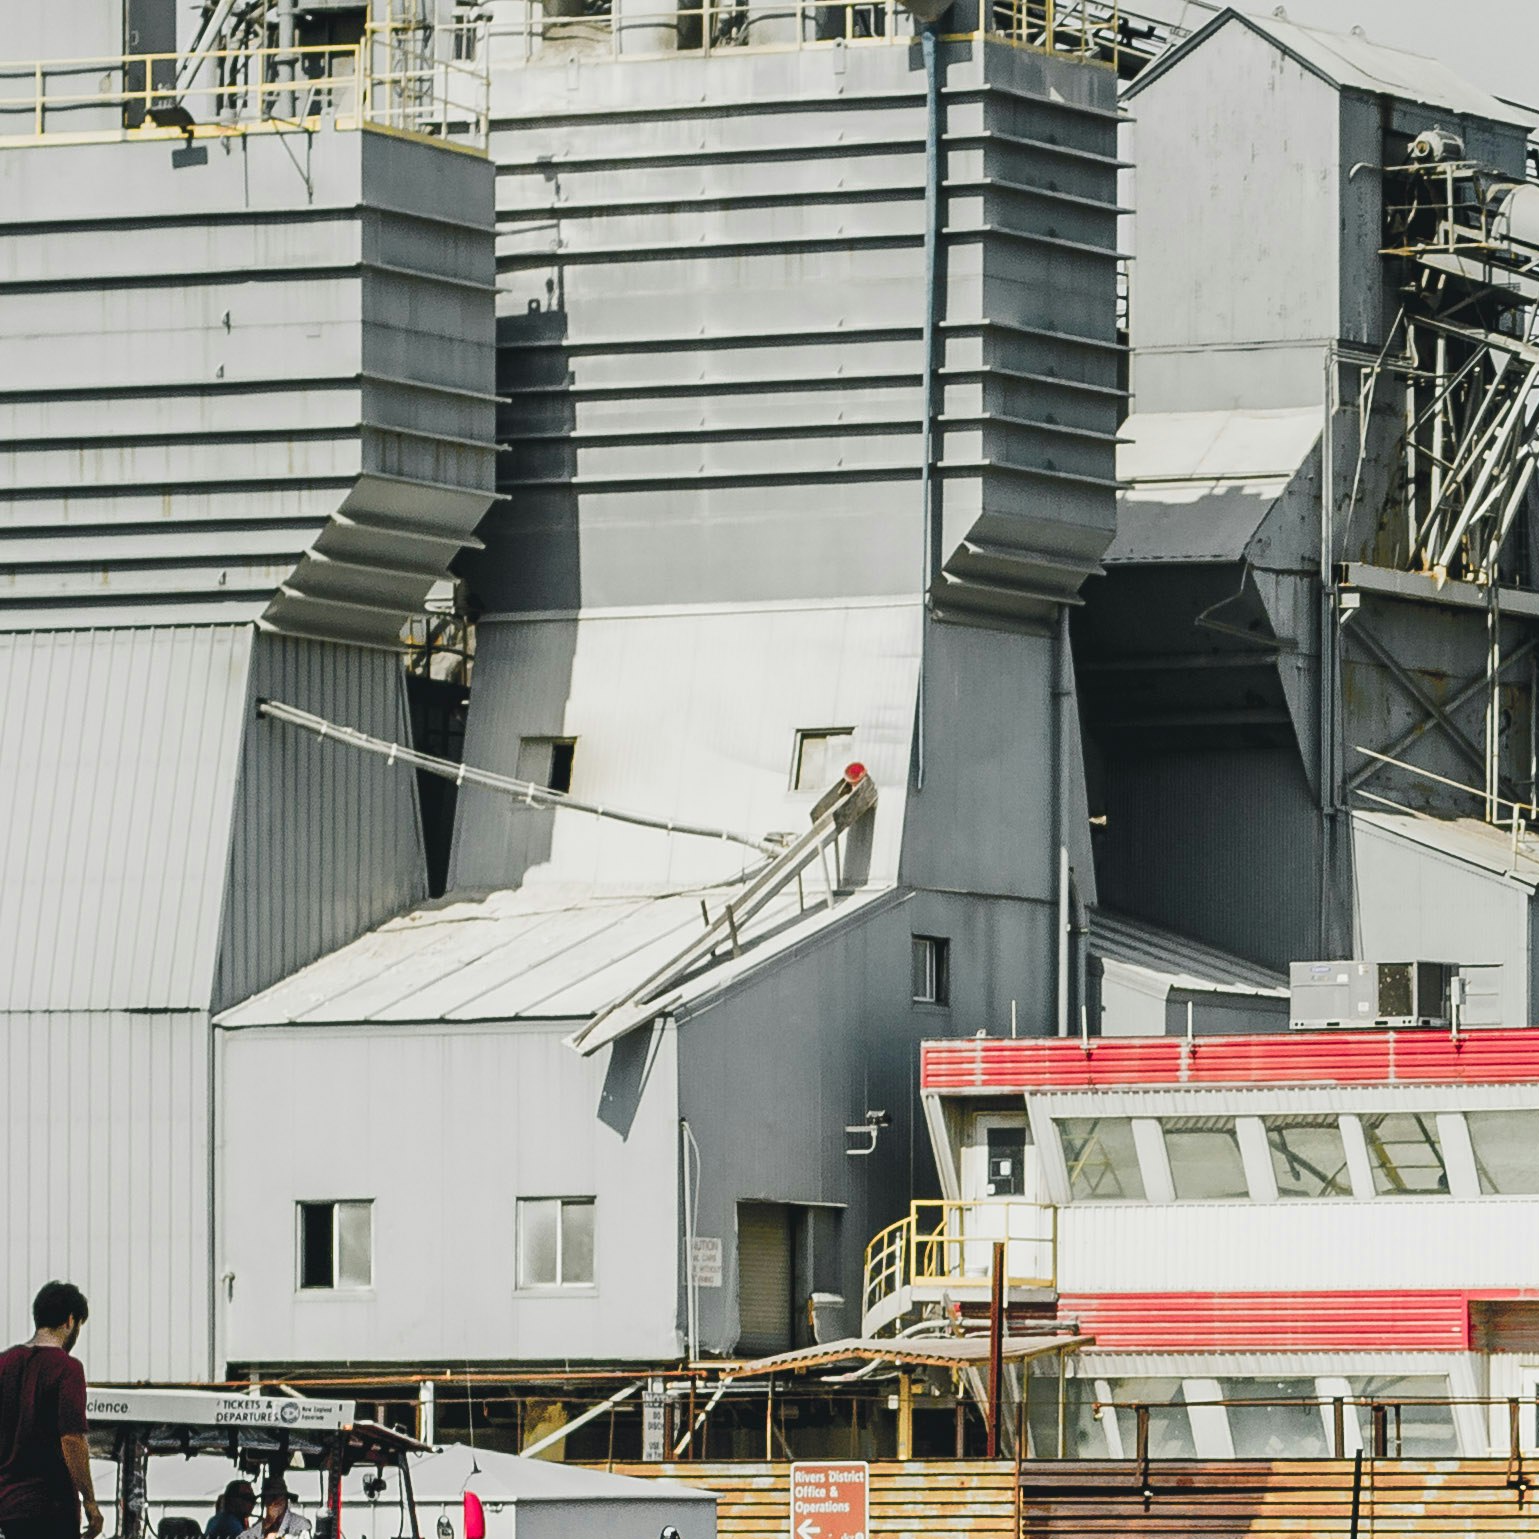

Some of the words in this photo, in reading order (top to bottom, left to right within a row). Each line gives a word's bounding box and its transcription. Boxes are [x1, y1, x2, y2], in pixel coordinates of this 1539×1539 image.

[86, 1401, 128, 1414] cience
[223, 1400, 261, 1410] TICKETS
[266, 1401, 273, 1409] &
[216, 1412, 279, 1422] DEPARTURES
[795, 1470, 825, 1483] Rivers
[829, 1470, 864, 1483] District
[795, 1486, 826, 1498] Office
[830, 1486, 838, 1498] &
[795, 1501, 850, 1515] Operations
